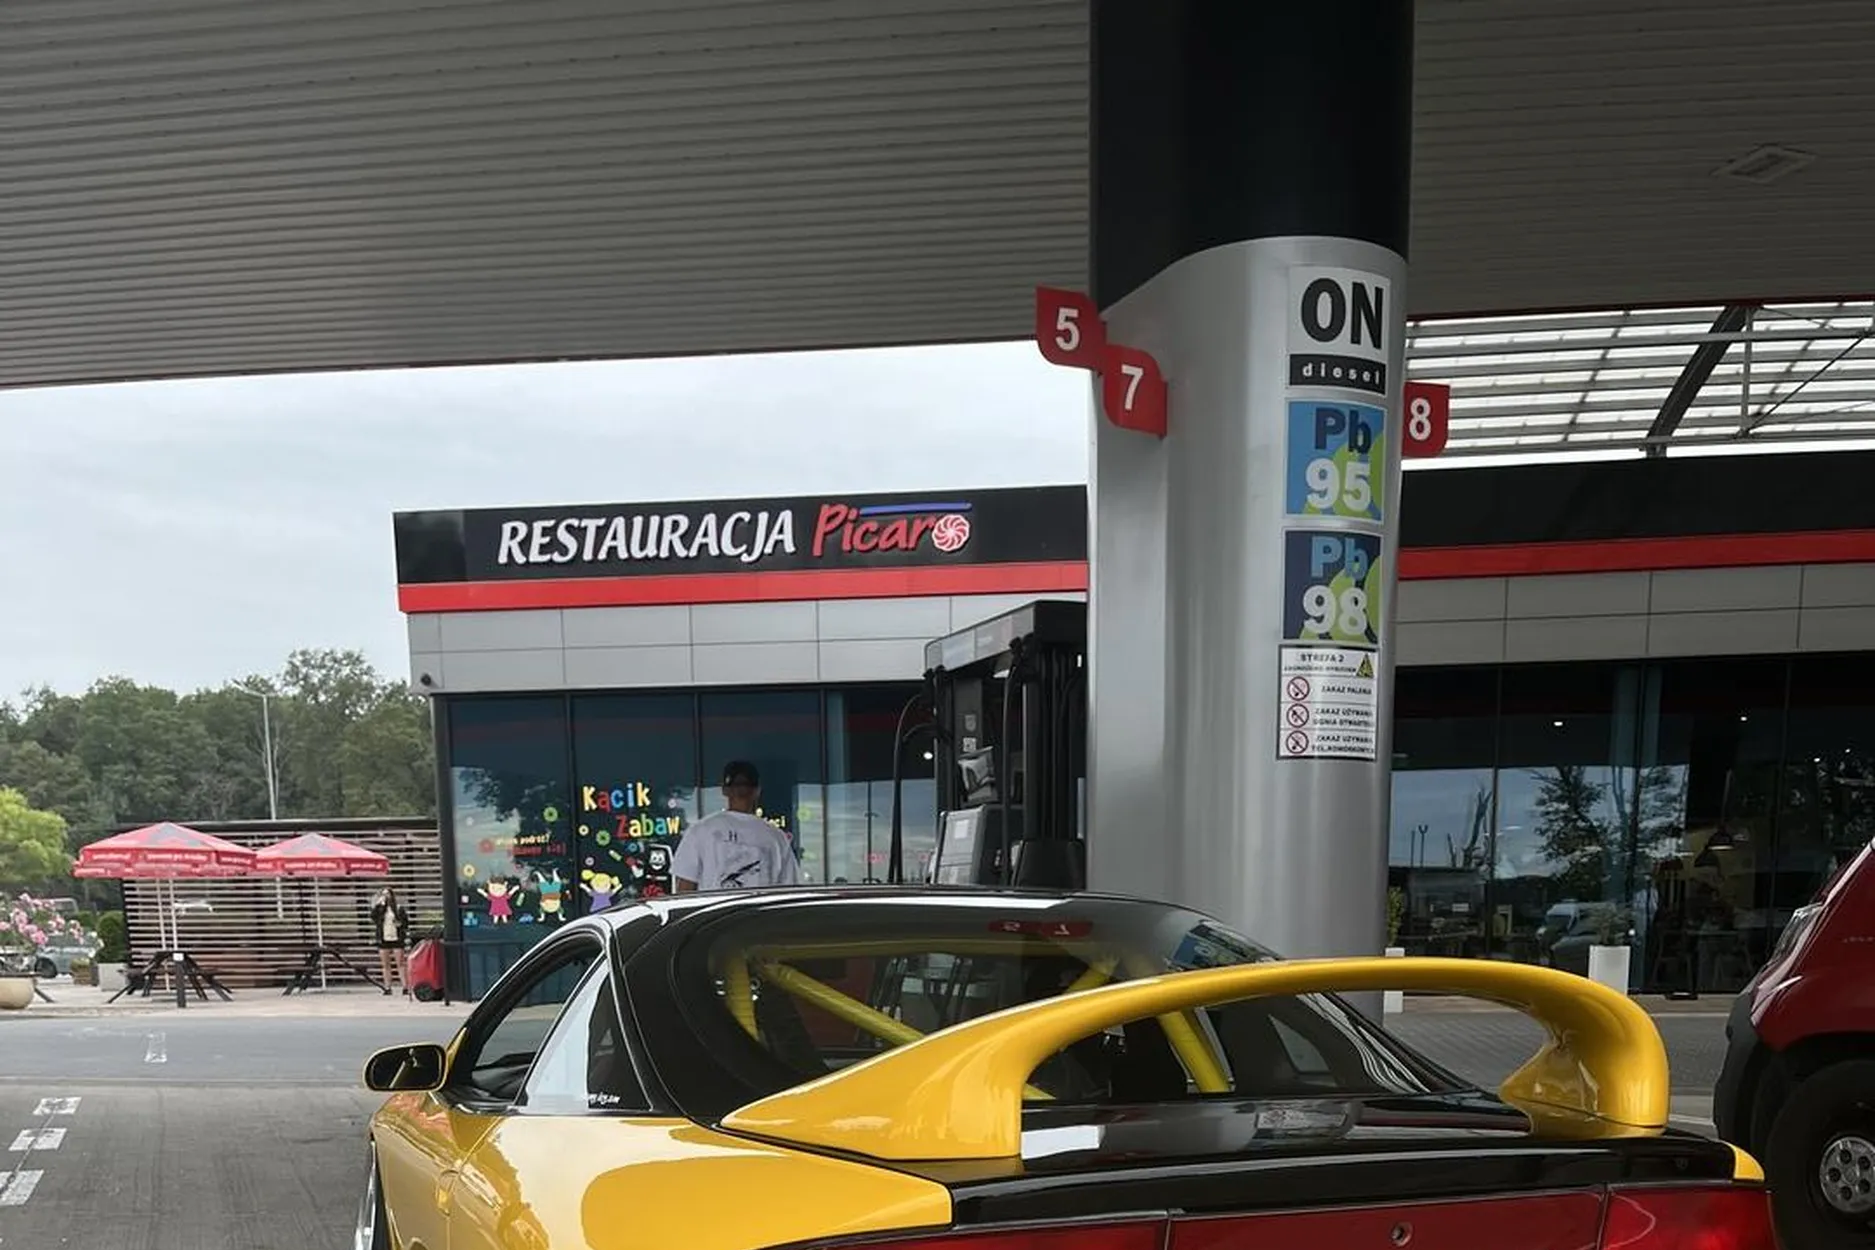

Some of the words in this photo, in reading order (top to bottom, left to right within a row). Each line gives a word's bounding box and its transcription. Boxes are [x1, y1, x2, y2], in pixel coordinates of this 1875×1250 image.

[1055, 307, 1080, 351] 5
[1301, 278, 1384, 350] ON
[1120, 364, 1144, 411] 7
[1302, 362, 1380, 385] diesel
[1315, 407, 1372, 454] Pb
[1408, 398, 1431, 441] 8
[1305, 458, 1371, 512] 95
[497, 510, 796, 563] RESTAURACJA
[812, 503, 971, 557] Picaro
[1311, 535, 1368, 581] Pb
[1303, 585, 1368, 635] 98
[615, 813, 680, 838] Zabaw
